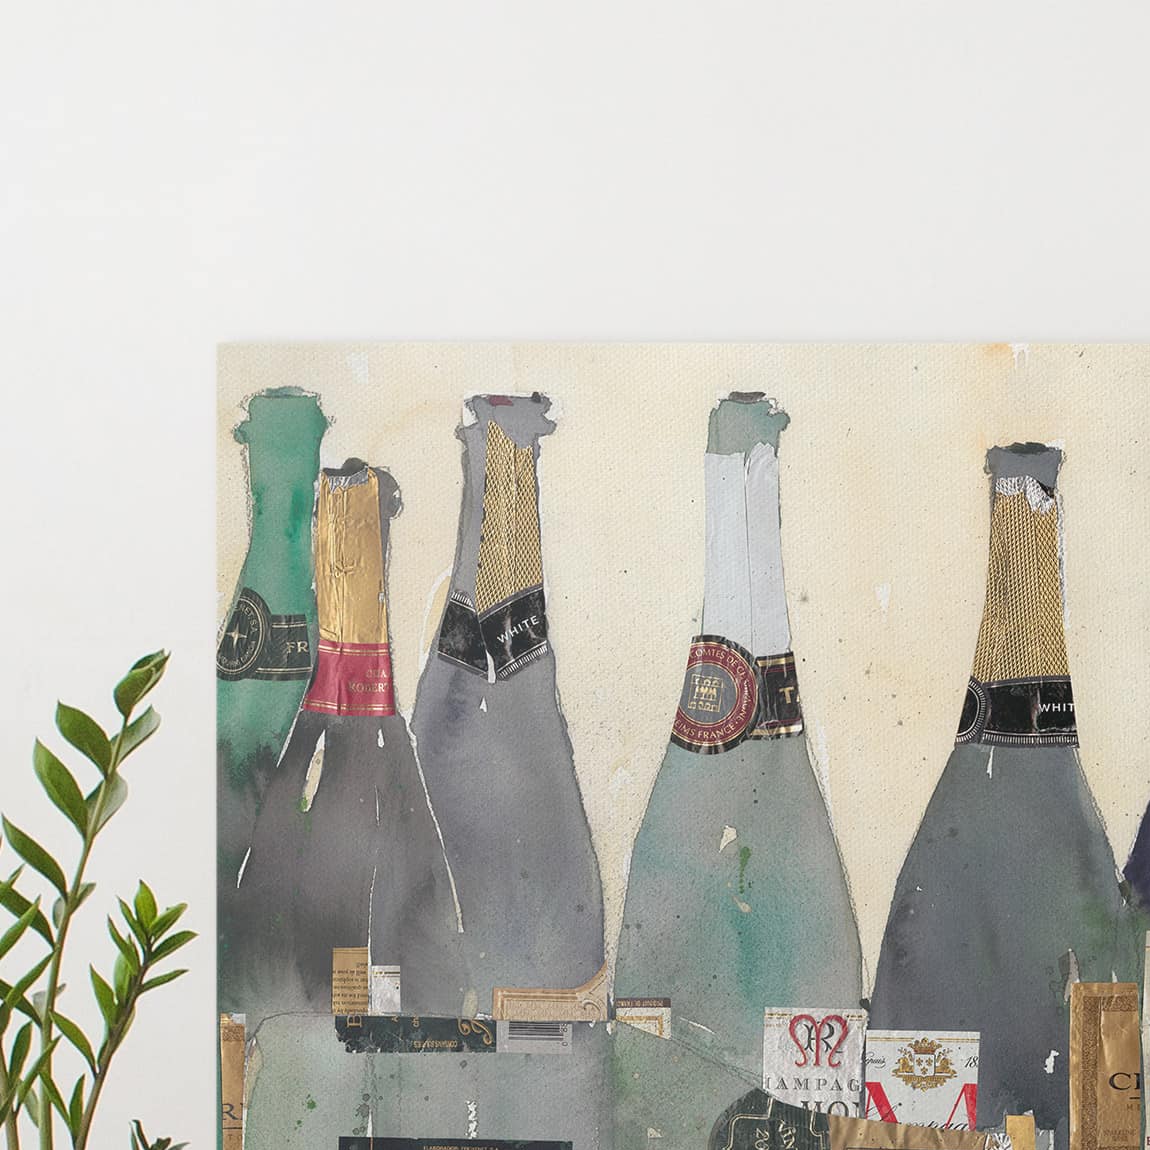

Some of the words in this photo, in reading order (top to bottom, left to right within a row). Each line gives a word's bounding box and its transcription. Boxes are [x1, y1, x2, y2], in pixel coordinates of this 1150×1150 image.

[496, 615, 540, 643] WHITE
[286, 640, 309, 654] FR
[727, 656, 738, 666] DE
[697, 724, 735, 739] FRANCE
